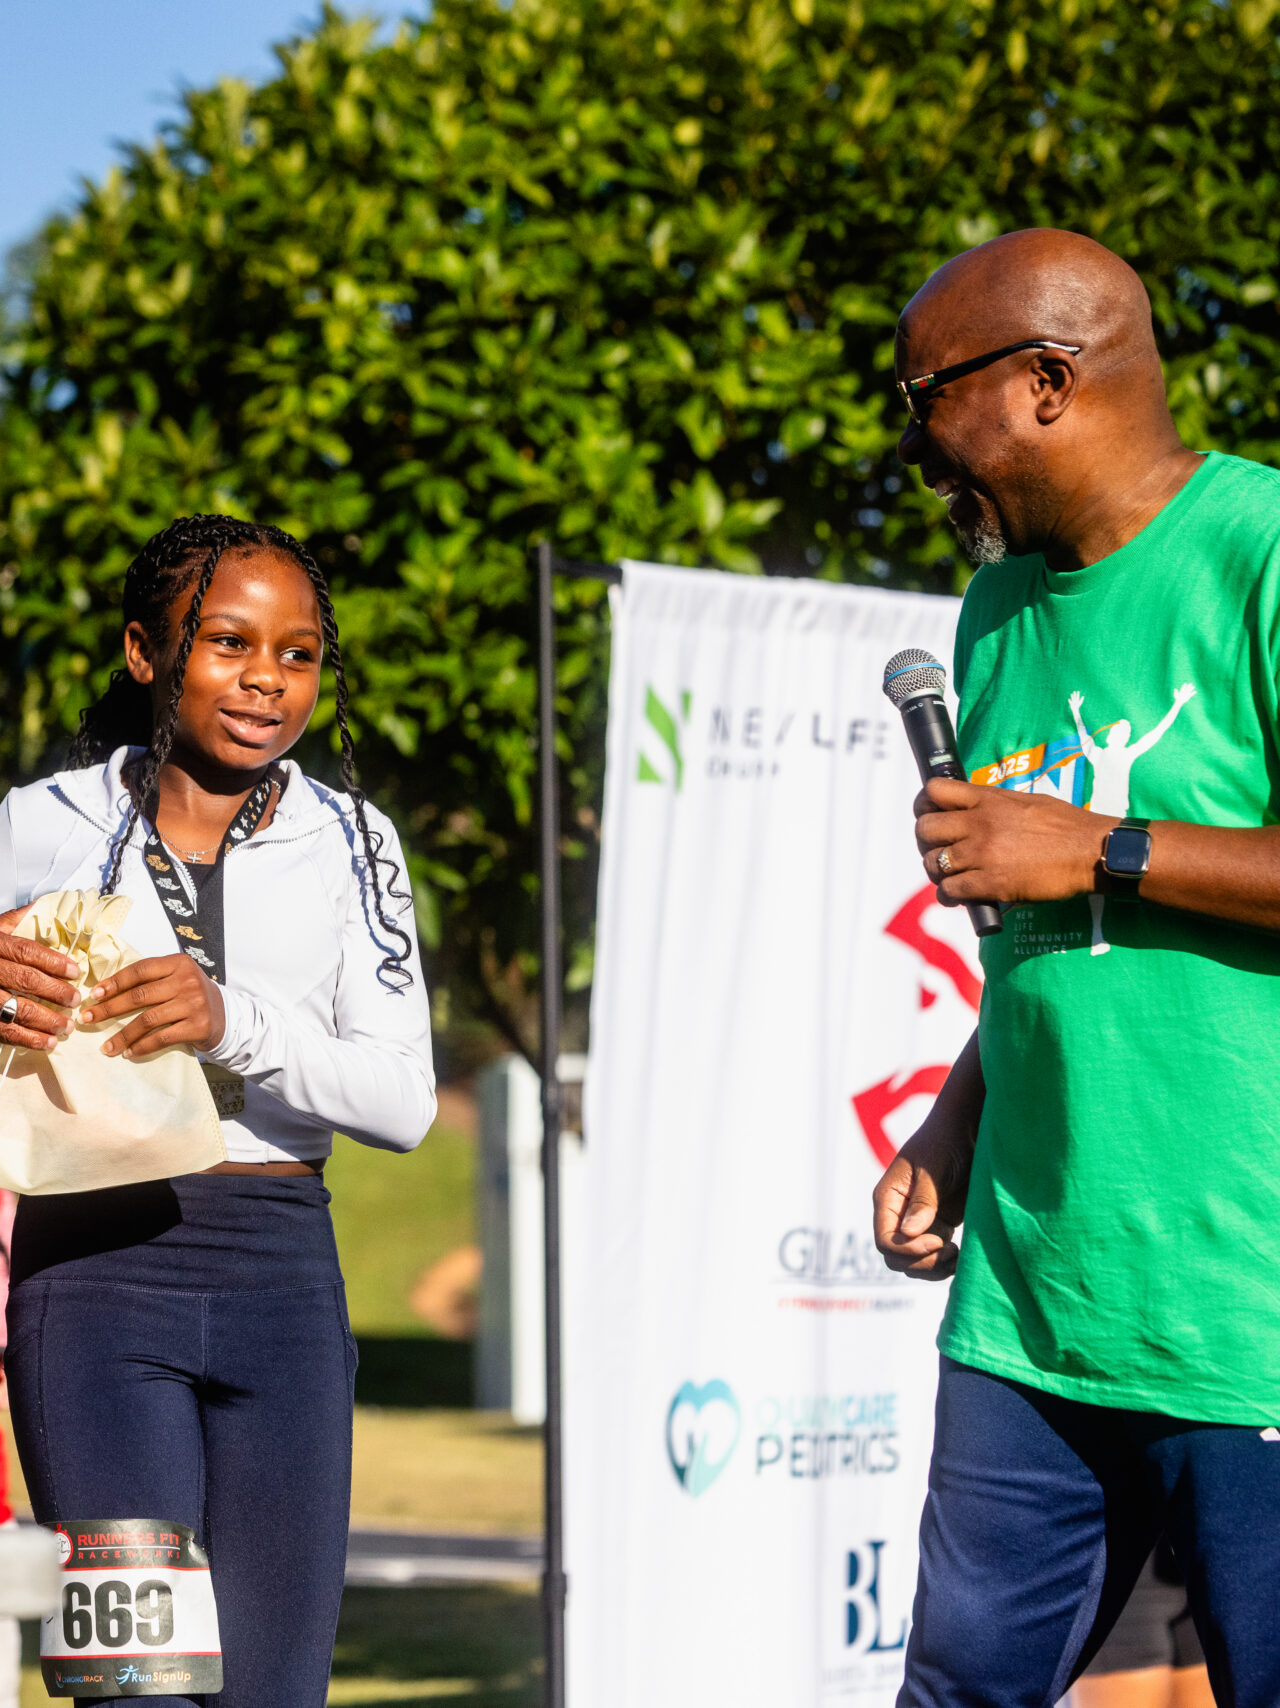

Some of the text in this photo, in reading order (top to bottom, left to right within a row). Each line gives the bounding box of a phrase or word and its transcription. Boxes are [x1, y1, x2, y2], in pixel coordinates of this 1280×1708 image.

[986, 754, 1030, 785] 2025
[1016, 911, 1034, 920] NEW
[1014, 922, 1033, 931] LIFE
[1014, 932, 1083, 943] COMMUNITY
[1014, 945, 1068, 955] ALLIANCE
[77, 1532, 180, 1546] RUNNERS FIT
[62, 1579, 174, 1649] 669
[131, 1670, 192, 1684] RunSignUp
